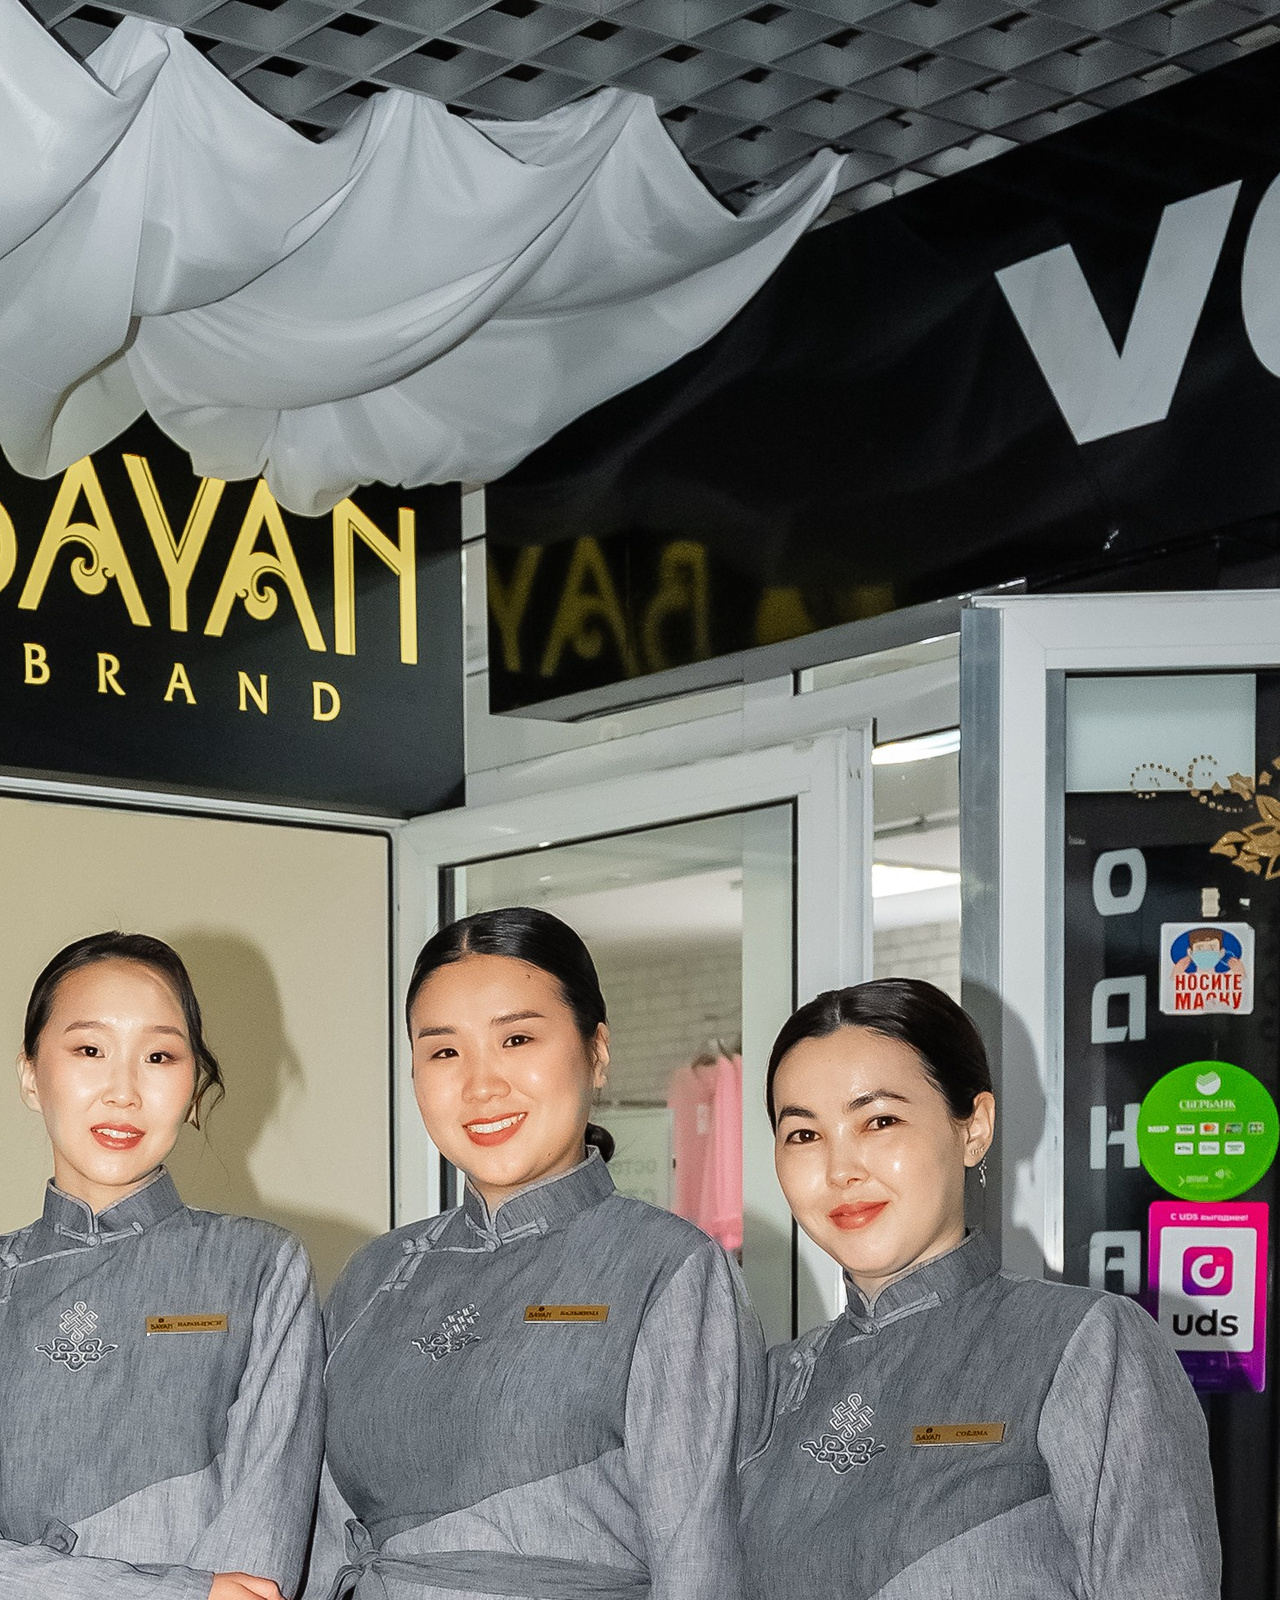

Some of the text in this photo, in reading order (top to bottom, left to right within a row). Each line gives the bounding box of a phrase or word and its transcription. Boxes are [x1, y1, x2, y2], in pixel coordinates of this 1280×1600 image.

[994, 172, 1280, 446] V
[22, 642, 342, 722] BRAND
[1175, 974, 1242, 991] НОСИТЕ
[1172, 1309, 1239, 1337] uds
